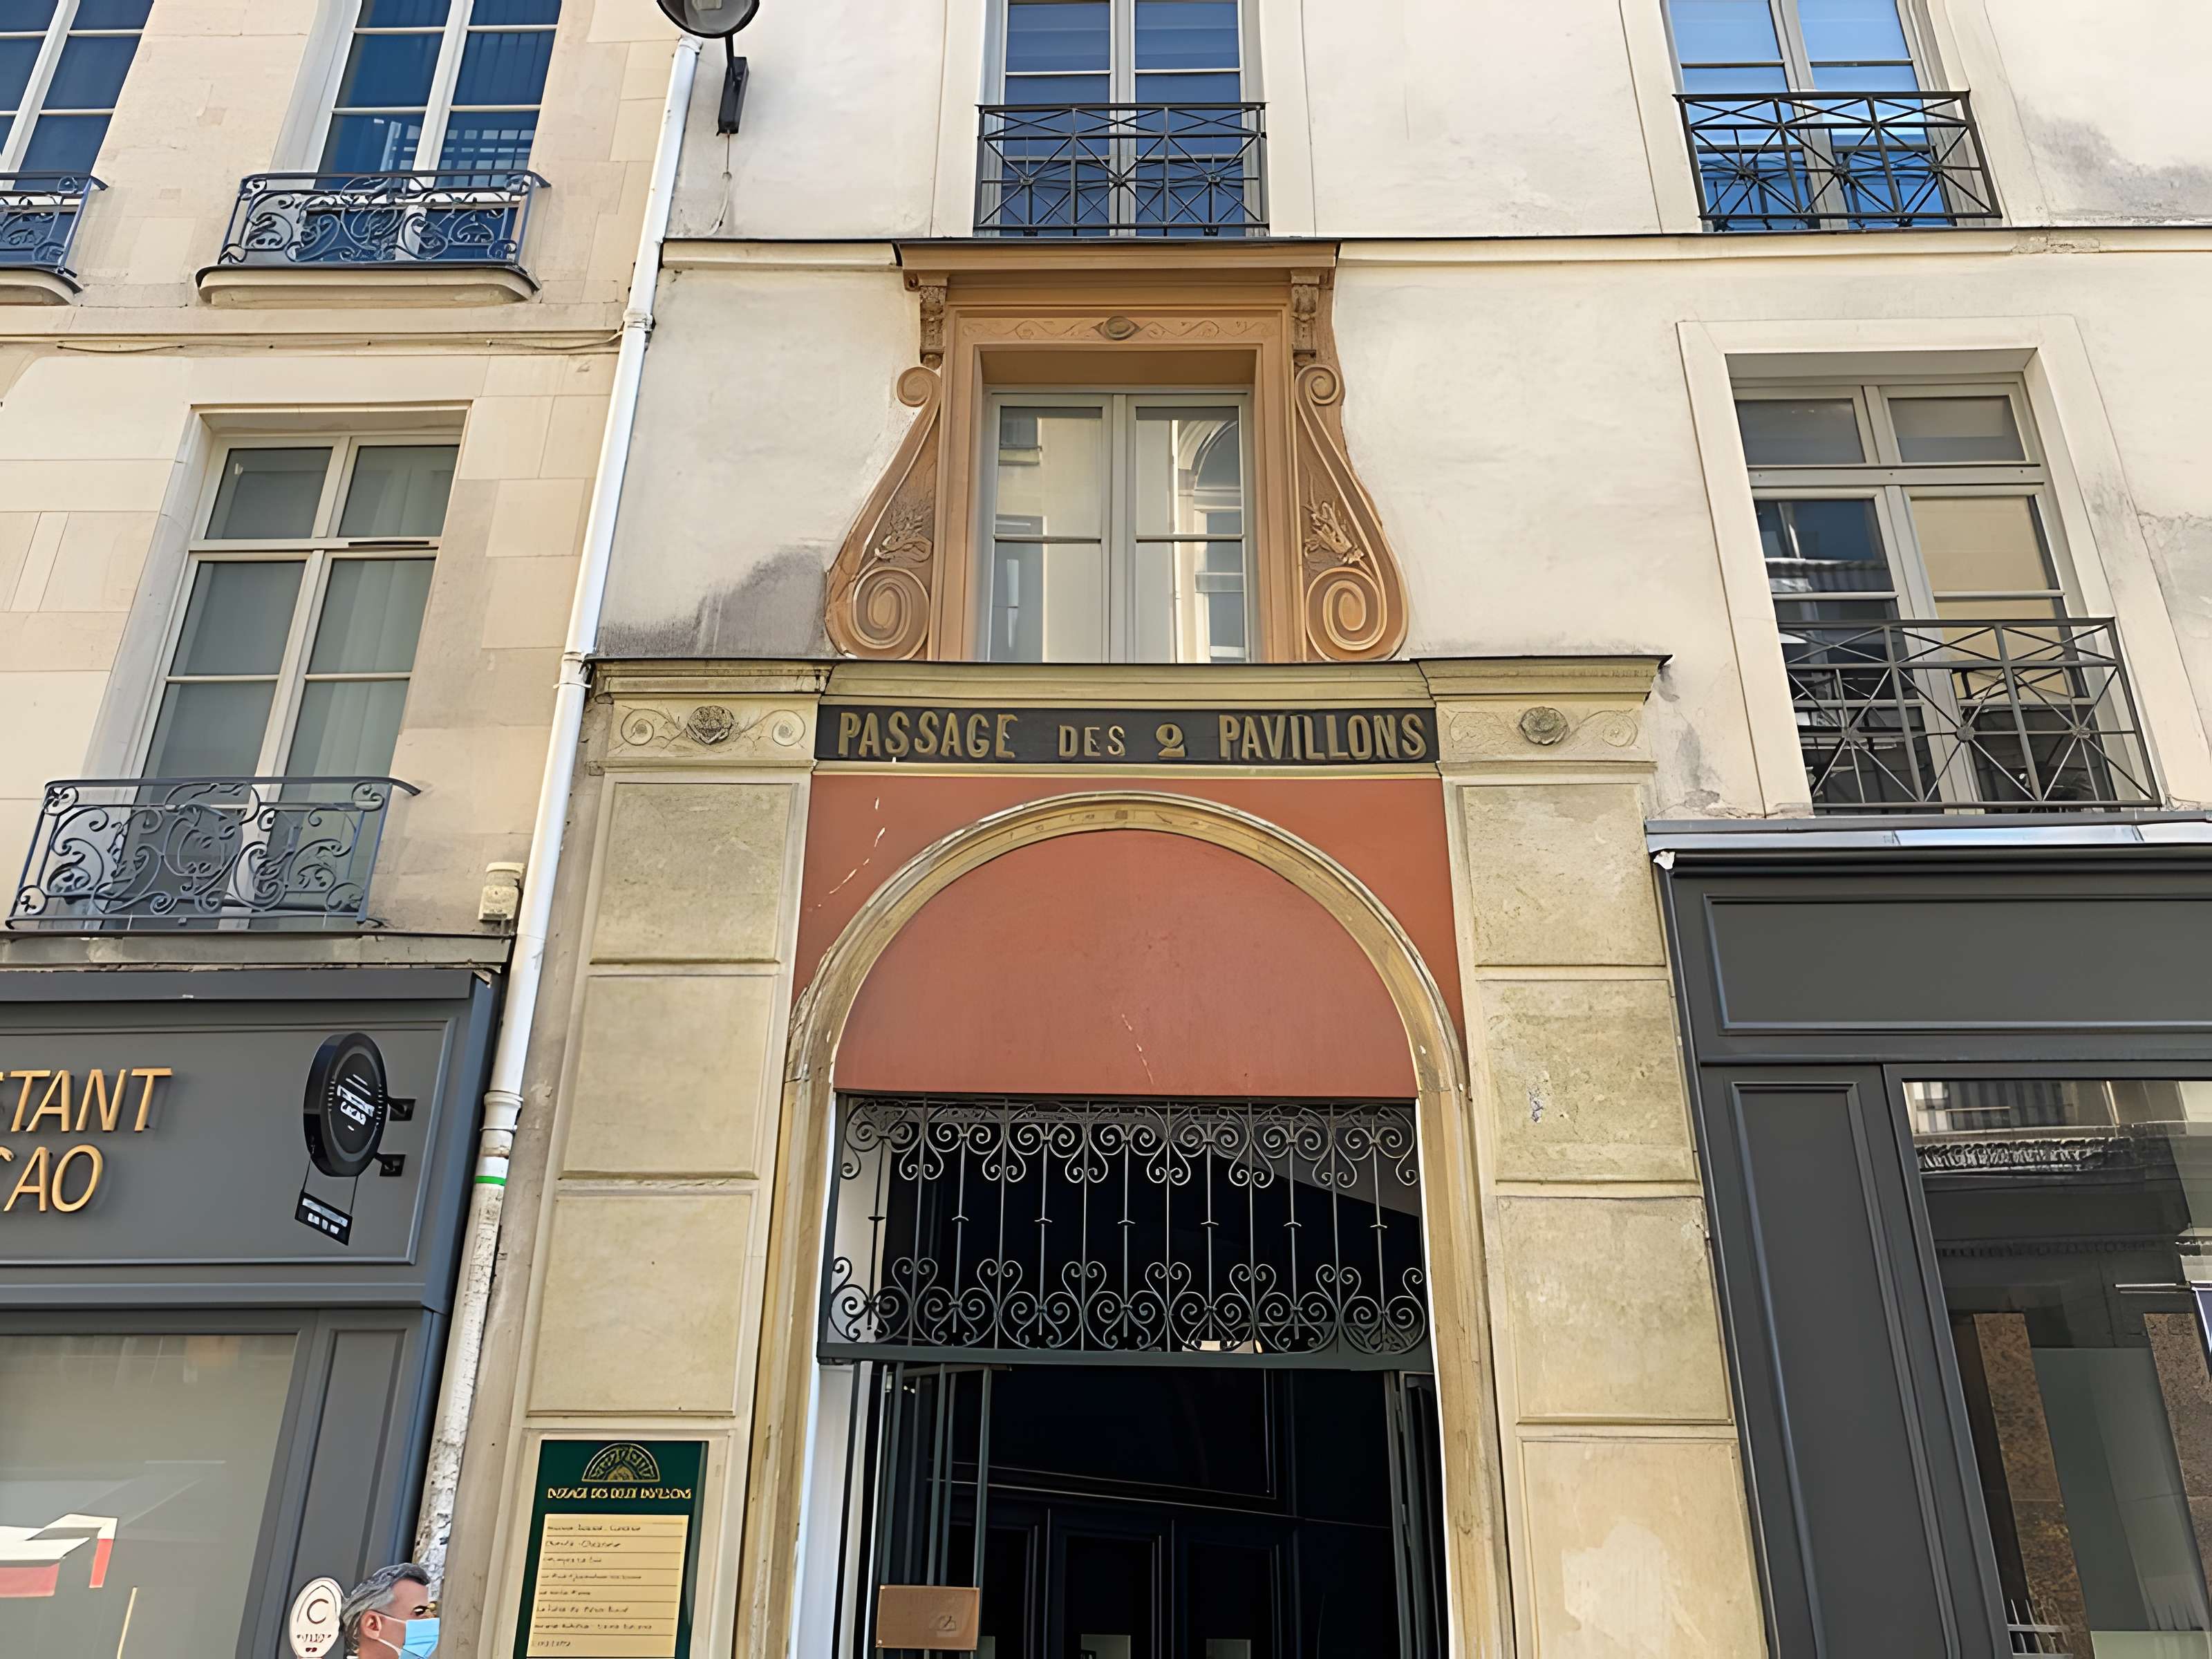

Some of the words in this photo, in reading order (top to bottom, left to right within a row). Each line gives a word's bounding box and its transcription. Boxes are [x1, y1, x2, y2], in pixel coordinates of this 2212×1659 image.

[838, 711, 1018, 758] PASSAGE
[1059, 724, 1125, 757] DES
[1155, 723, 1185, 758] 2
[1219, 713, 1427, 760] PAVILLONS
[0, 1067, 172, 1132] TANT
[0, 1144, 103, 1212] AO
